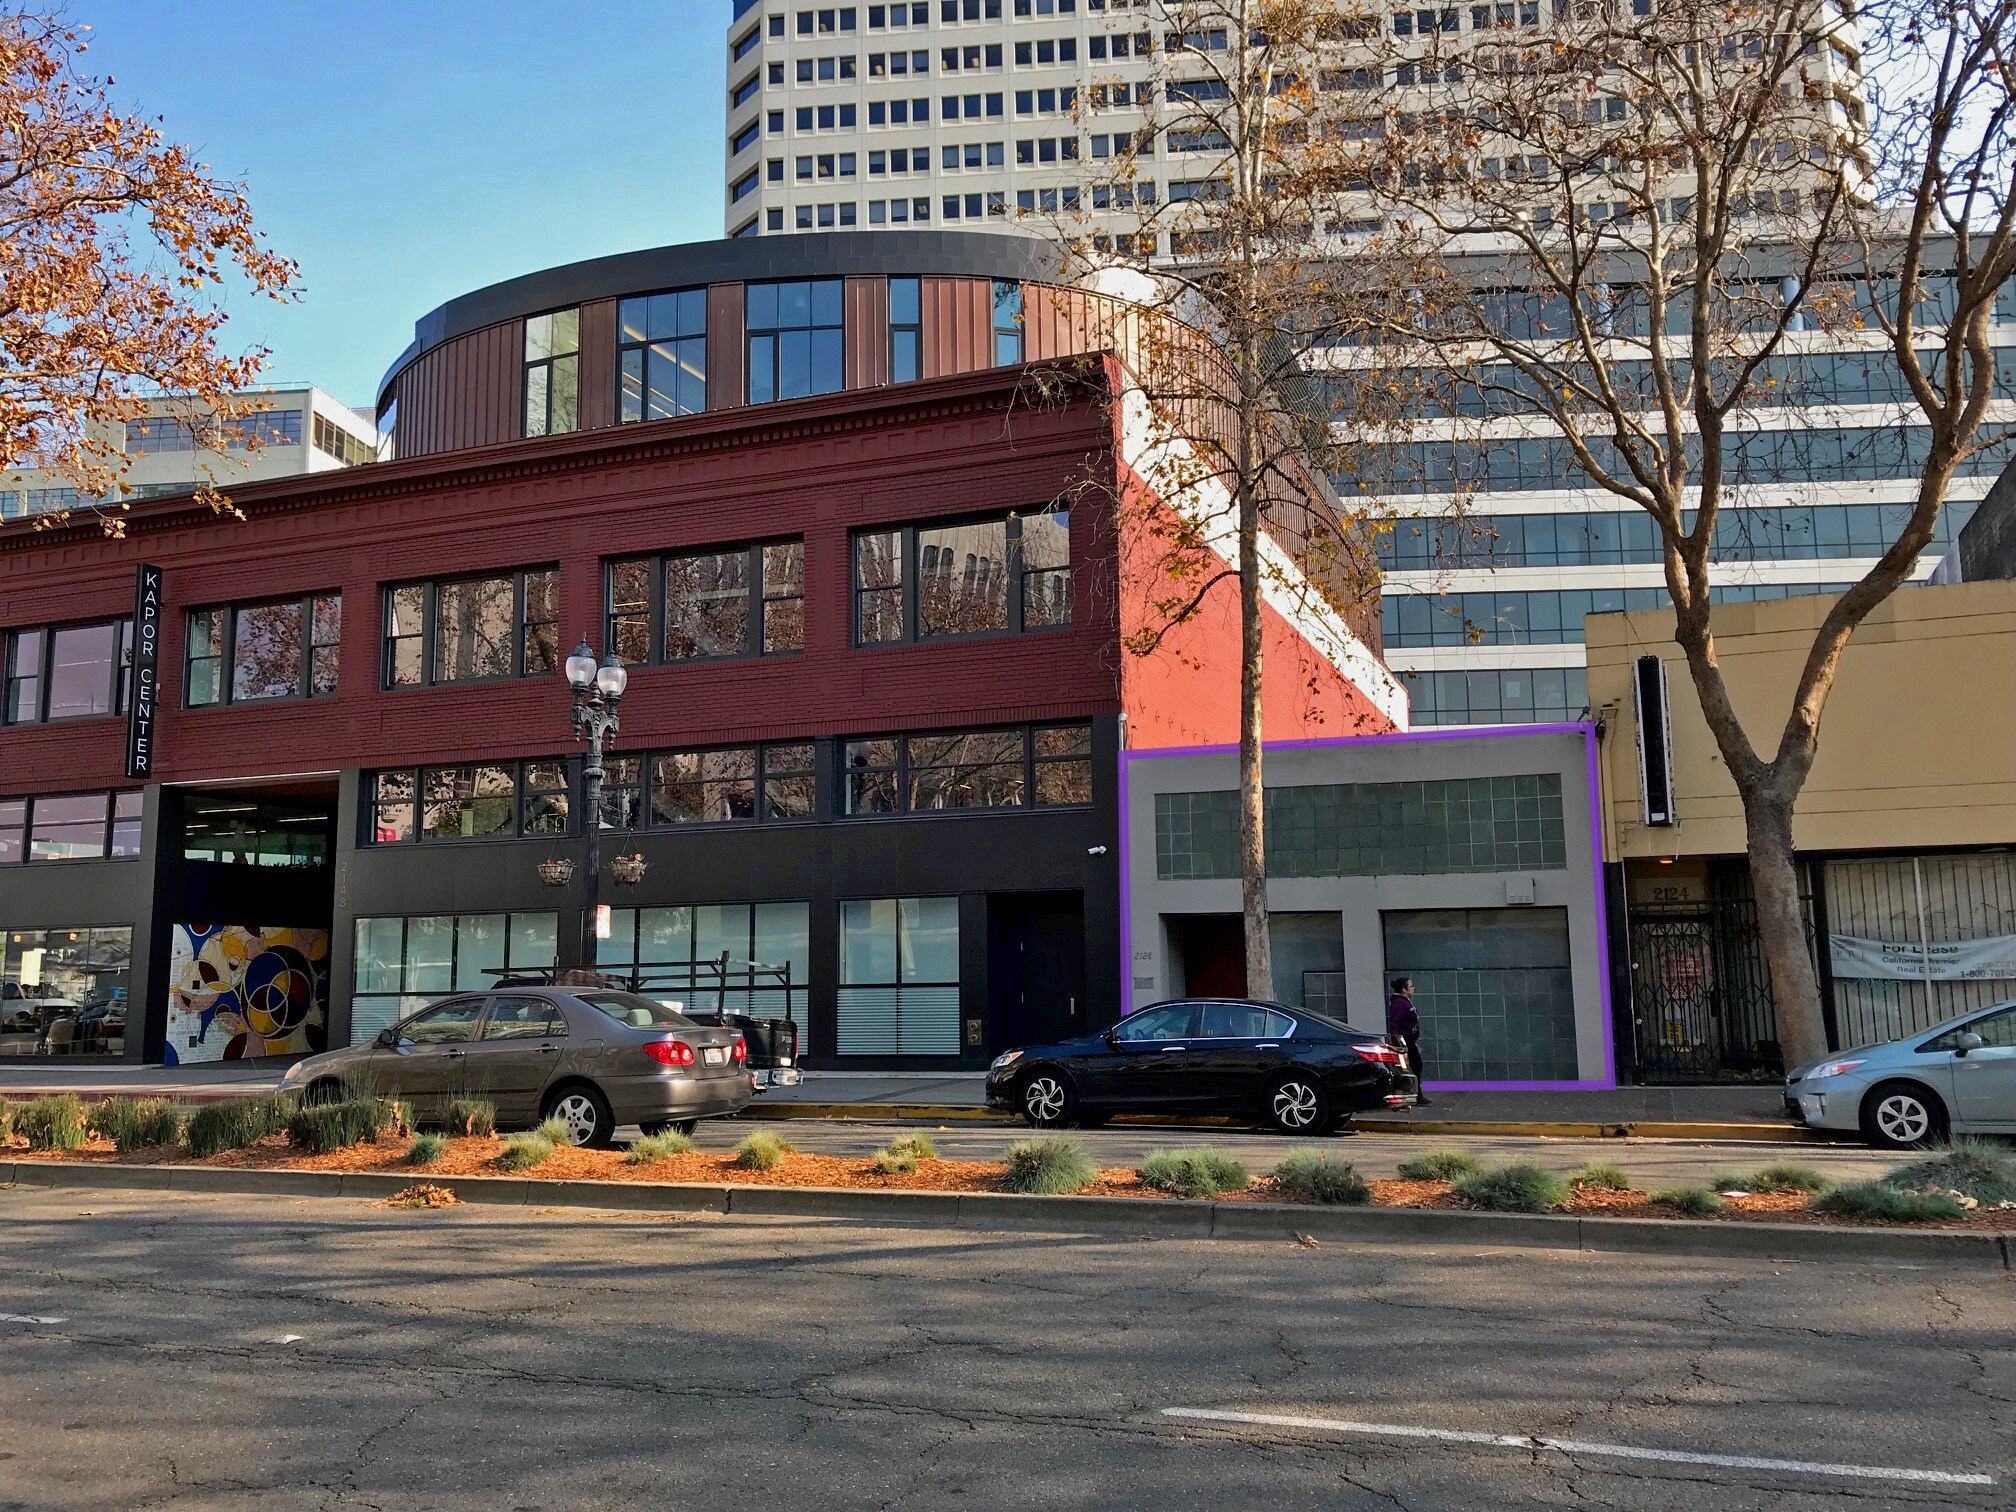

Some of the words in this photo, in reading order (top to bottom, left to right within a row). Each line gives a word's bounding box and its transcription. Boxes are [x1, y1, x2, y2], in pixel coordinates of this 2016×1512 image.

[142, 572, 157, 657] KAPOR
[136, 668, 152, 771] CENTER
[340, 861, 348, 908] 2148
[1653, 886, 1689, 901] 2124
[1882, 944, 1907, 953] For
[1913, 945, 1959, 954] Lease
[1134, 951, 1153, 960] 2128
[1882, 956, 1924, 964] California
[1918, 966, 1946, 974] Etate
